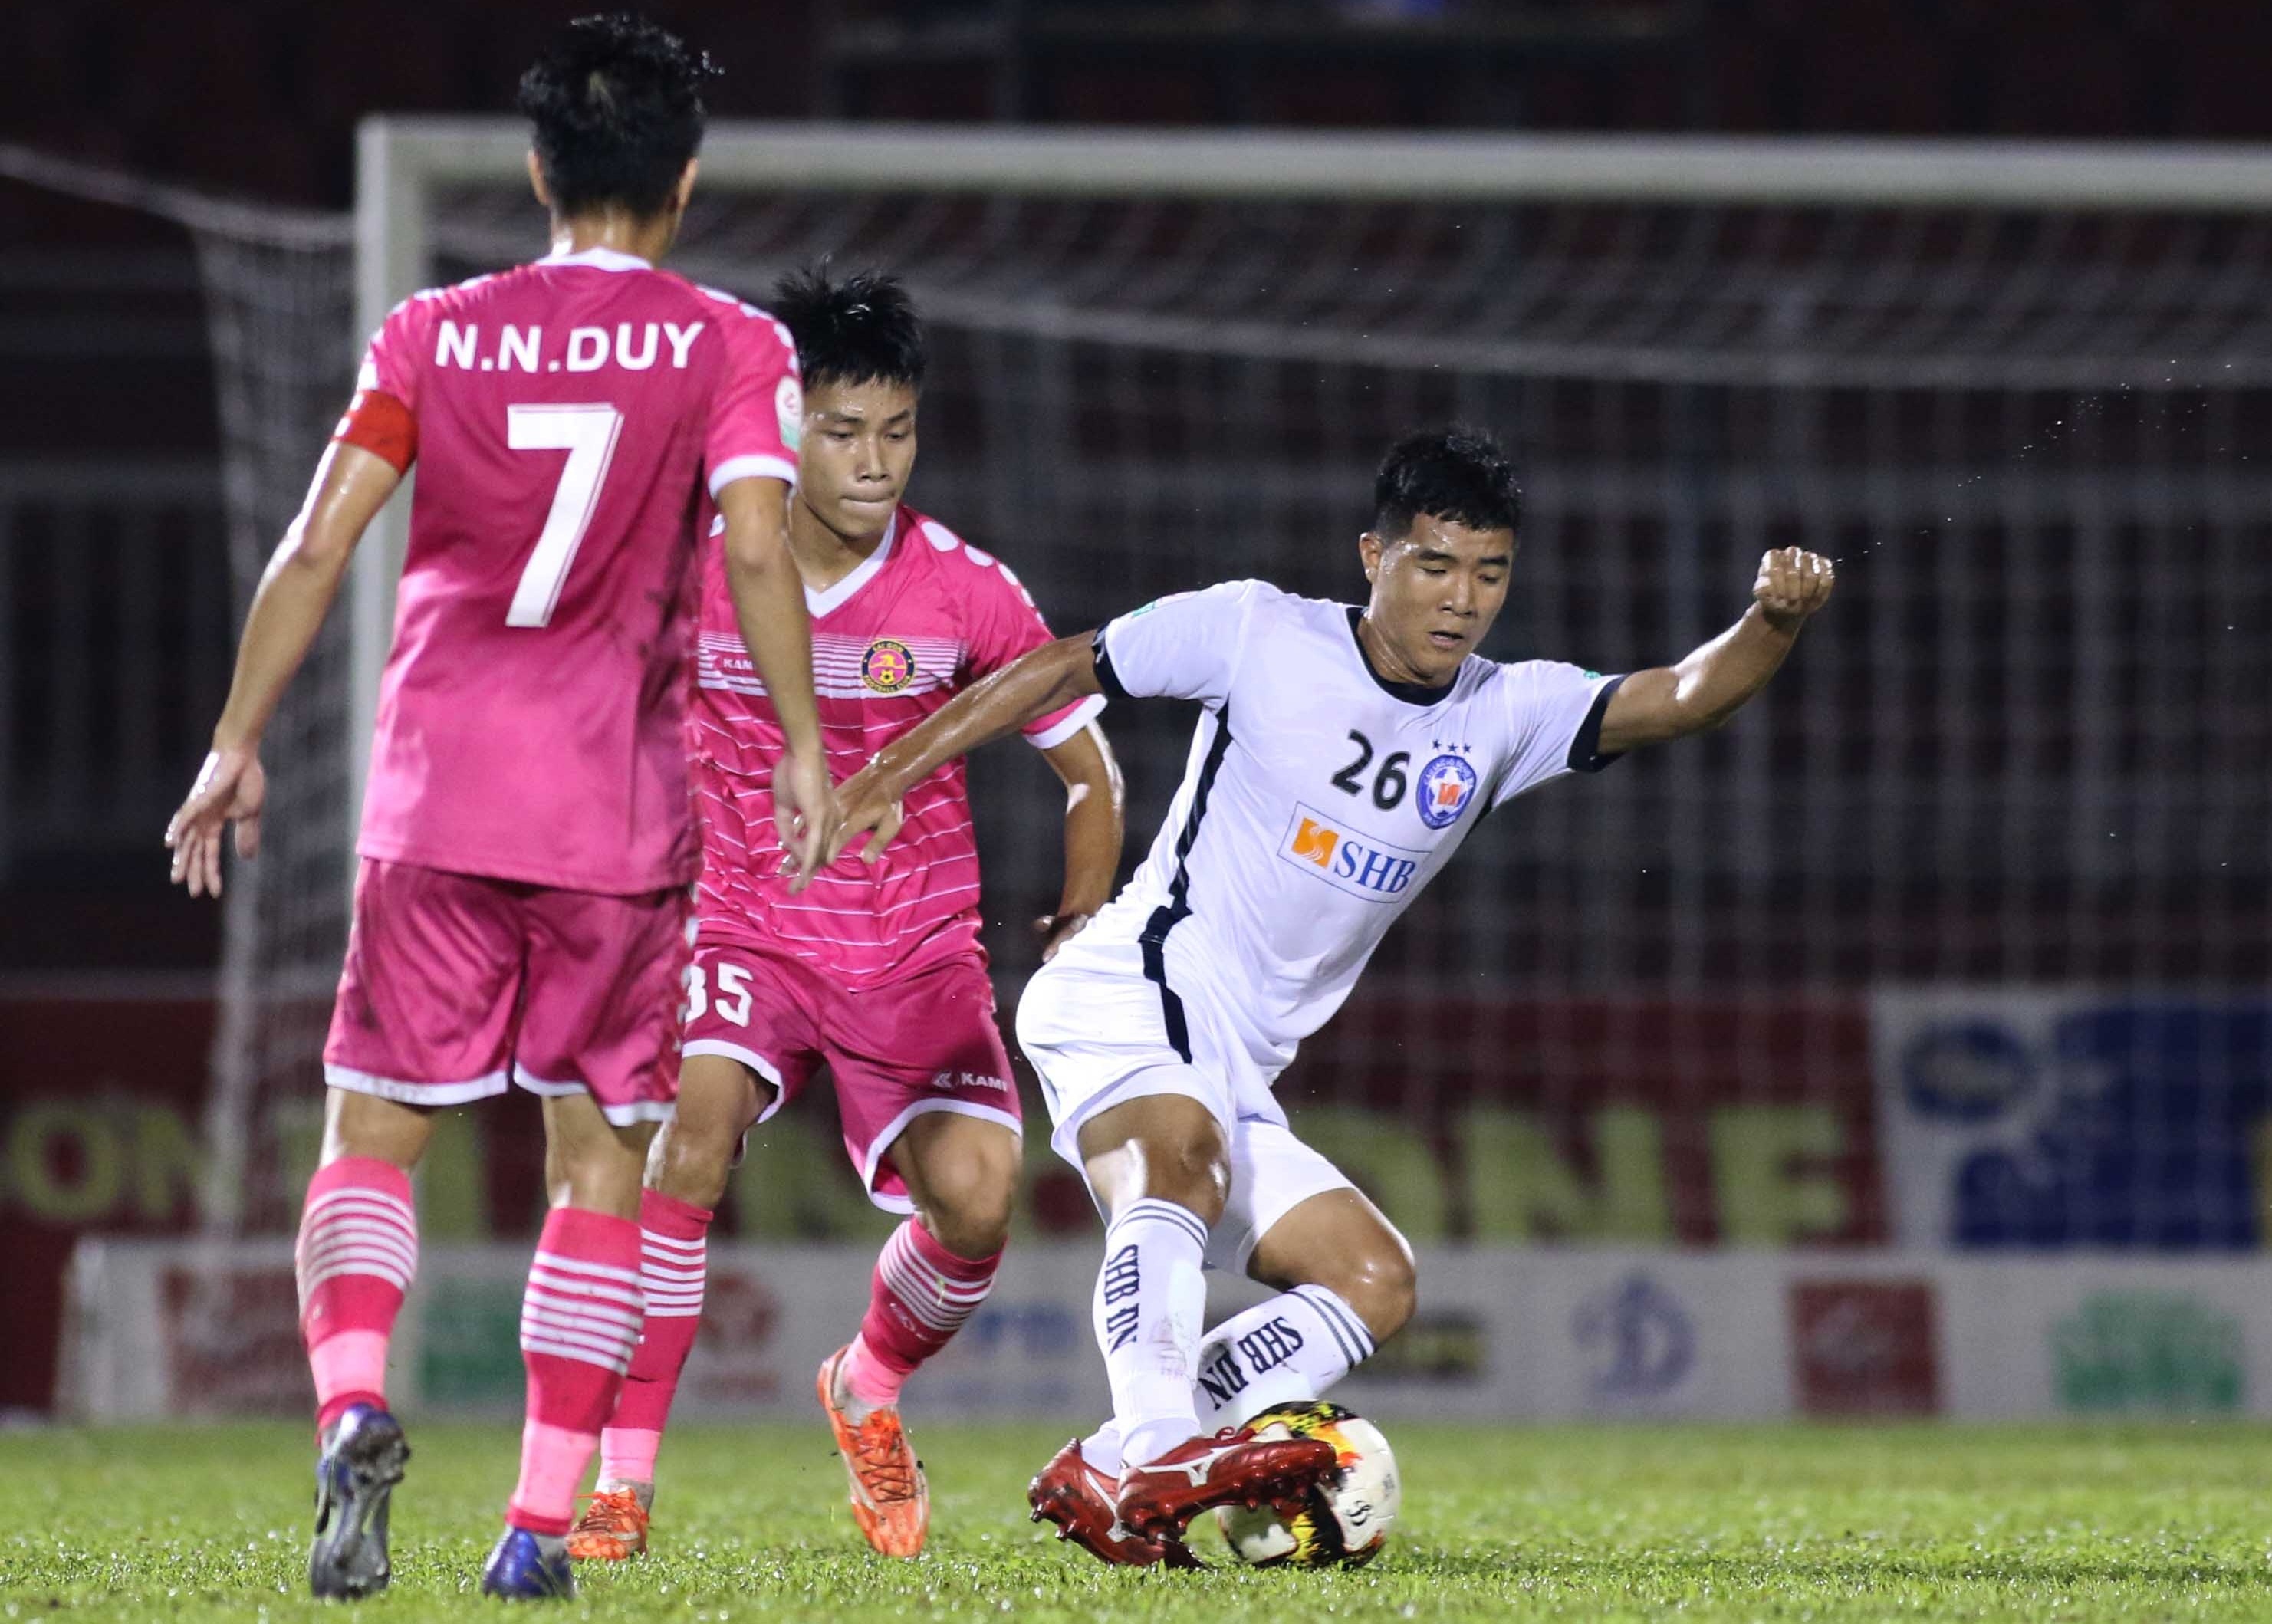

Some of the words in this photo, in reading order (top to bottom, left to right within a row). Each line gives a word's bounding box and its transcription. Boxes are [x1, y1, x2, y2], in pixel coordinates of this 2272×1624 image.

[434, 319, 704, 373] N.N.DUY
[505, 401, 624, 629] 7
[1330, 728, 1410, 812] 26
[1333, 840, 1416, 894] SHB
[1104, 1244, 1140, 1306] SHB
[1236, 1316, 1304, 1376] SHB
